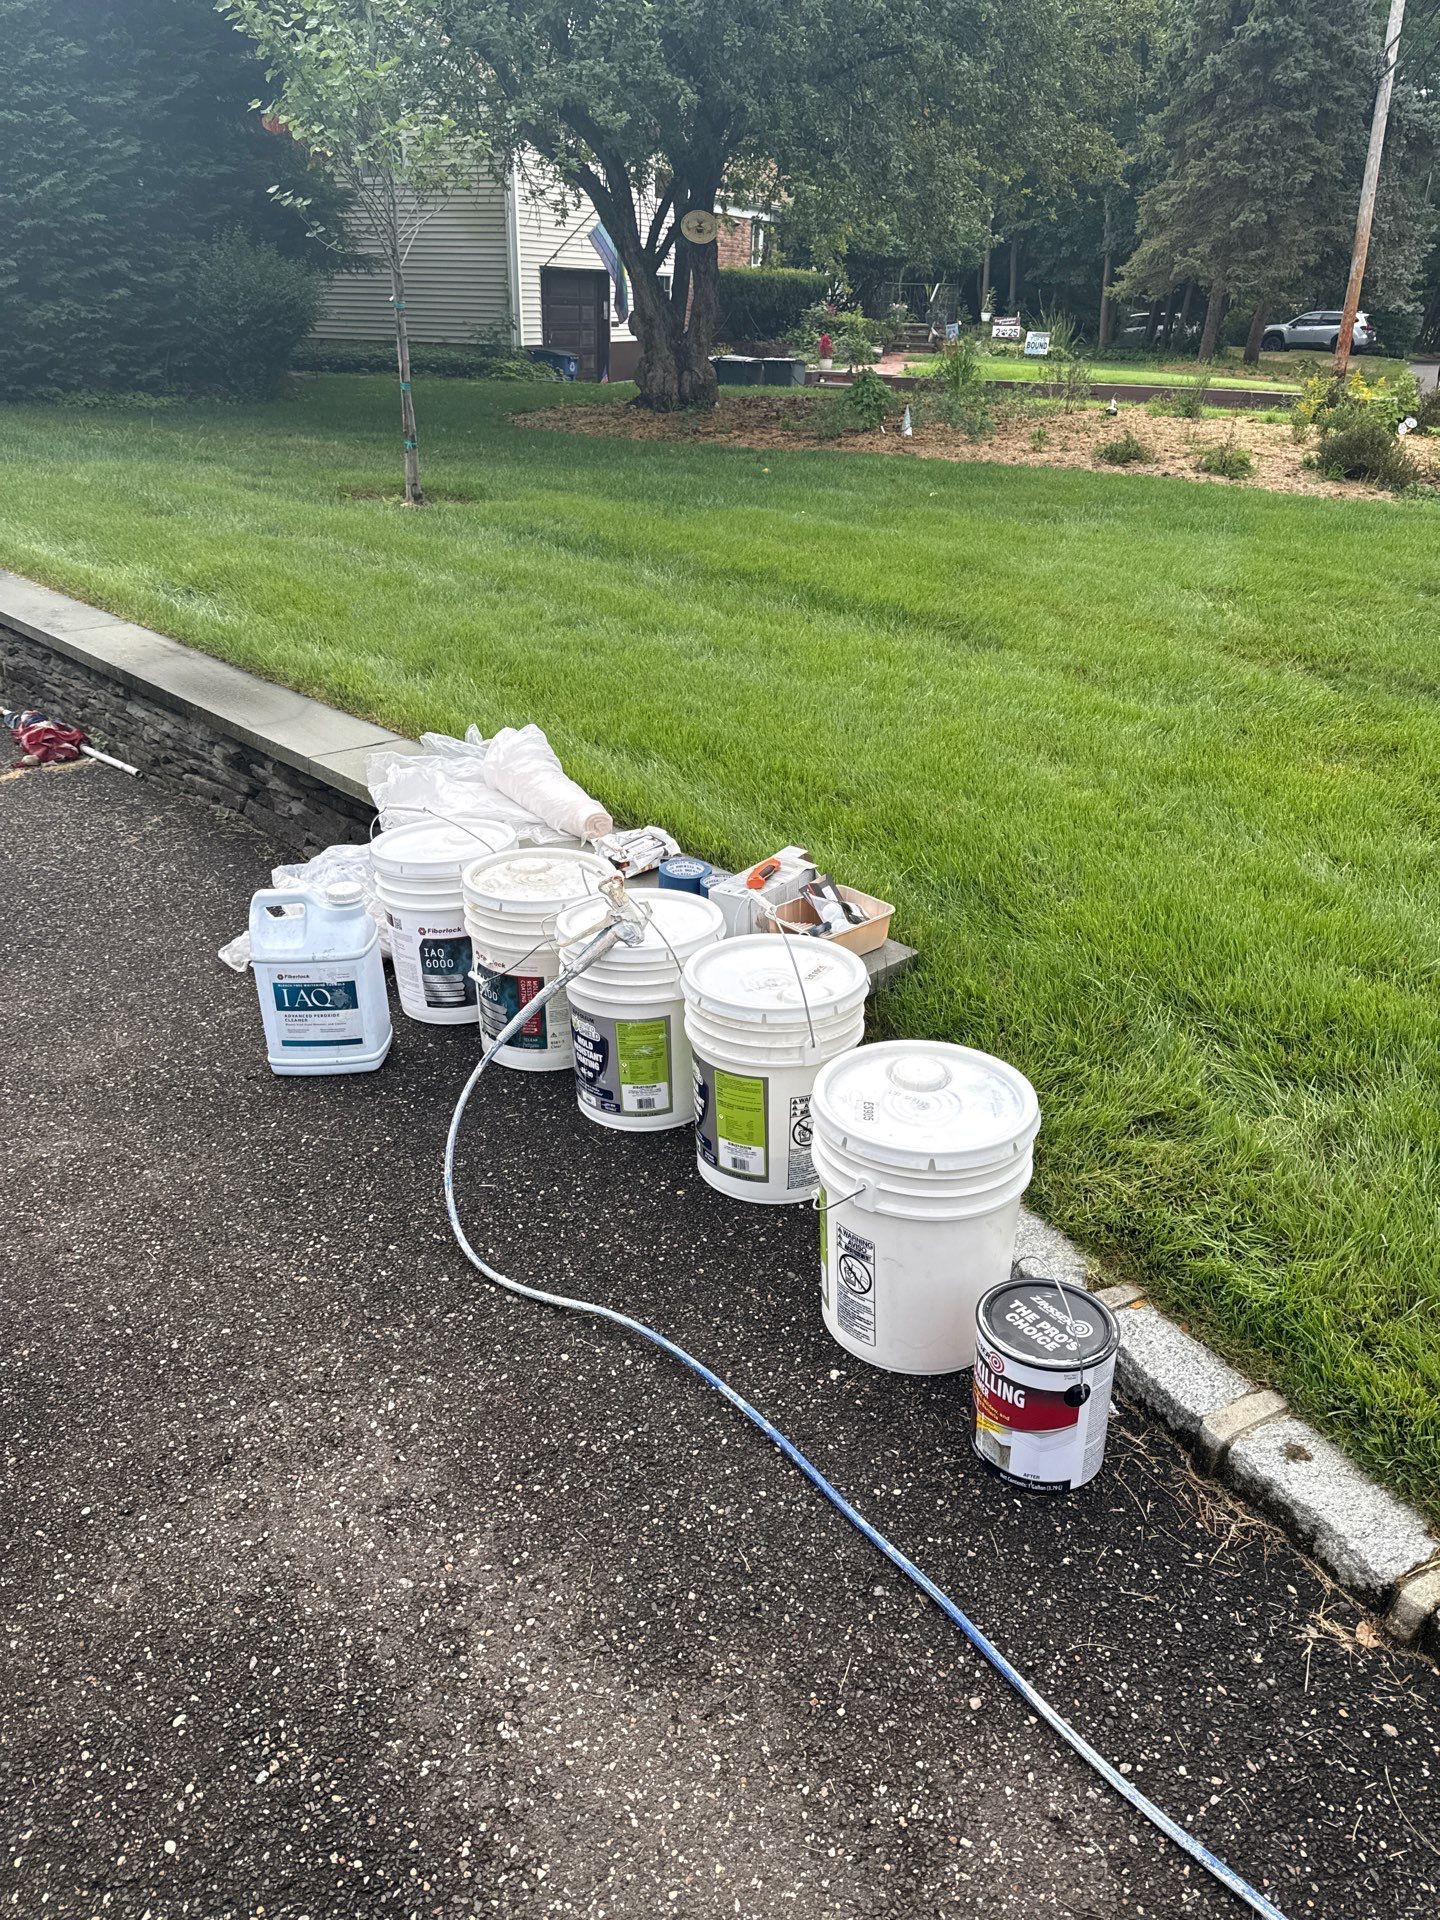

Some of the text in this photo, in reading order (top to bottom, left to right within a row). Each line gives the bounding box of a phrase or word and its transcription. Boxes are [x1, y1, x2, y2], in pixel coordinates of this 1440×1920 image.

[1026, 341, 1048, 350] BOUND
[423, 947, 445, 959] IAQ
[425, 959, 454, 969] 6000
[281, 988, 336, 1008] IAQ
[842, 1228, 874, 1250] WARNING
[1005, 1312, 1061, 1352] CHOICE
[1009, 1298, 1081, 1351] THE PRO'S
[1022, 1472, 1041, 1480] AFTER
